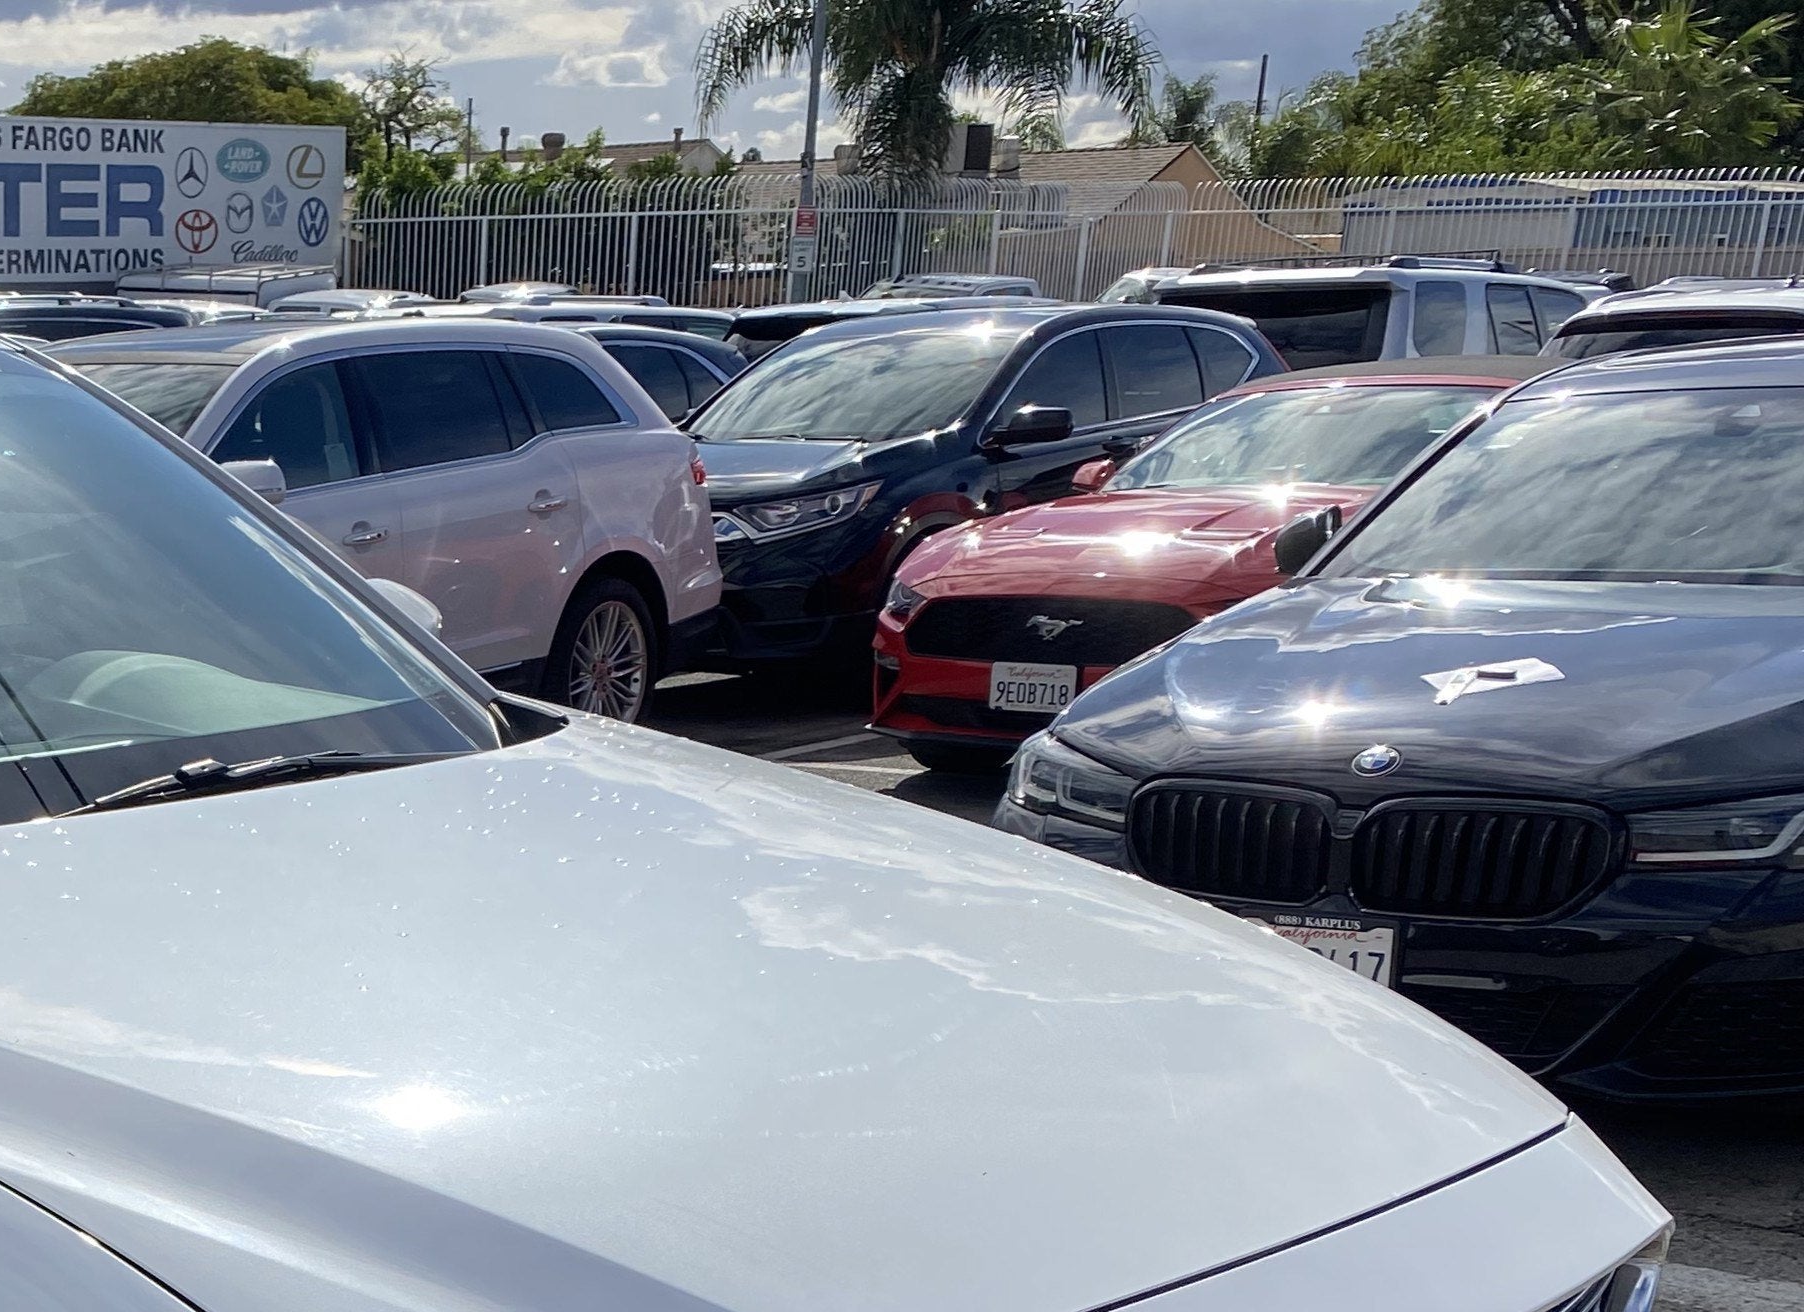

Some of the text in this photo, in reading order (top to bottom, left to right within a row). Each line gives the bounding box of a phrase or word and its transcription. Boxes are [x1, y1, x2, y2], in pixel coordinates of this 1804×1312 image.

[12, 125, 91, 151] FARGO
[101, 128, 165, 154] BANK
[231, 239, 299, 264] Cadillac
[796, 255, 807, 268] 5
[1274, 914, 1362, 930] (888) KARPLUS
